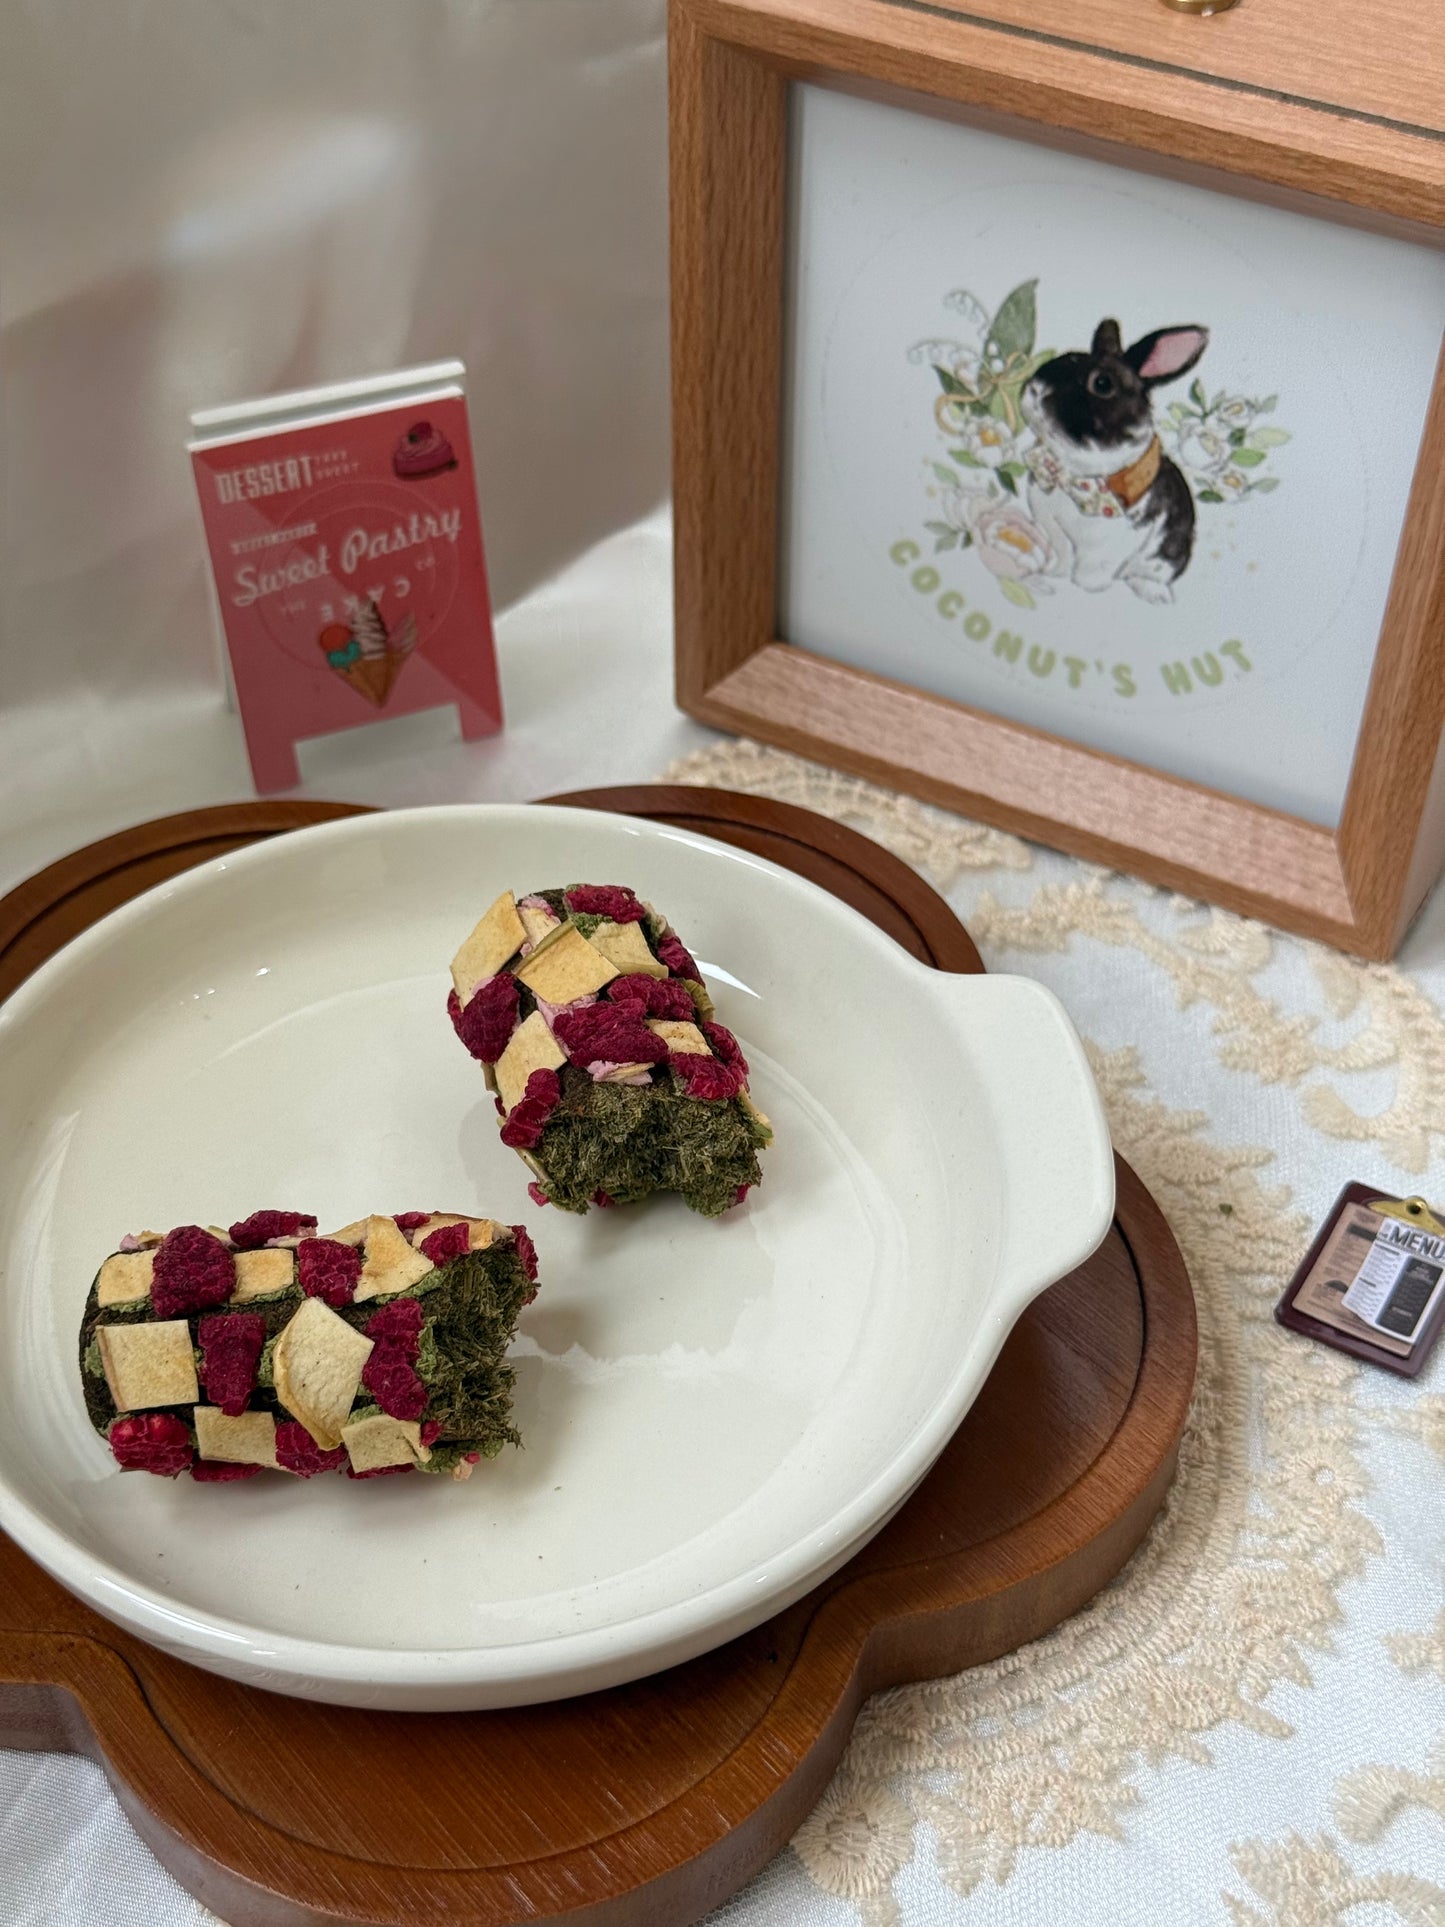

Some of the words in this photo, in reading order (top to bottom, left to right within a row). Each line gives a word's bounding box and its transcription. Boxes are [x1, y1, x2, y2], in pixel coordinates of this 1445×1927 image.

[217, 454, 314, 503] DESSERT
[232, 552, 330, 607] Sweet
[341, 508, 463, 574] Pastry
[889, 538, 1137, 698] COCONUT'S
[1160, 638, 1253, 696] HUT
[1388, 1225, 1445, 1259] MENU
